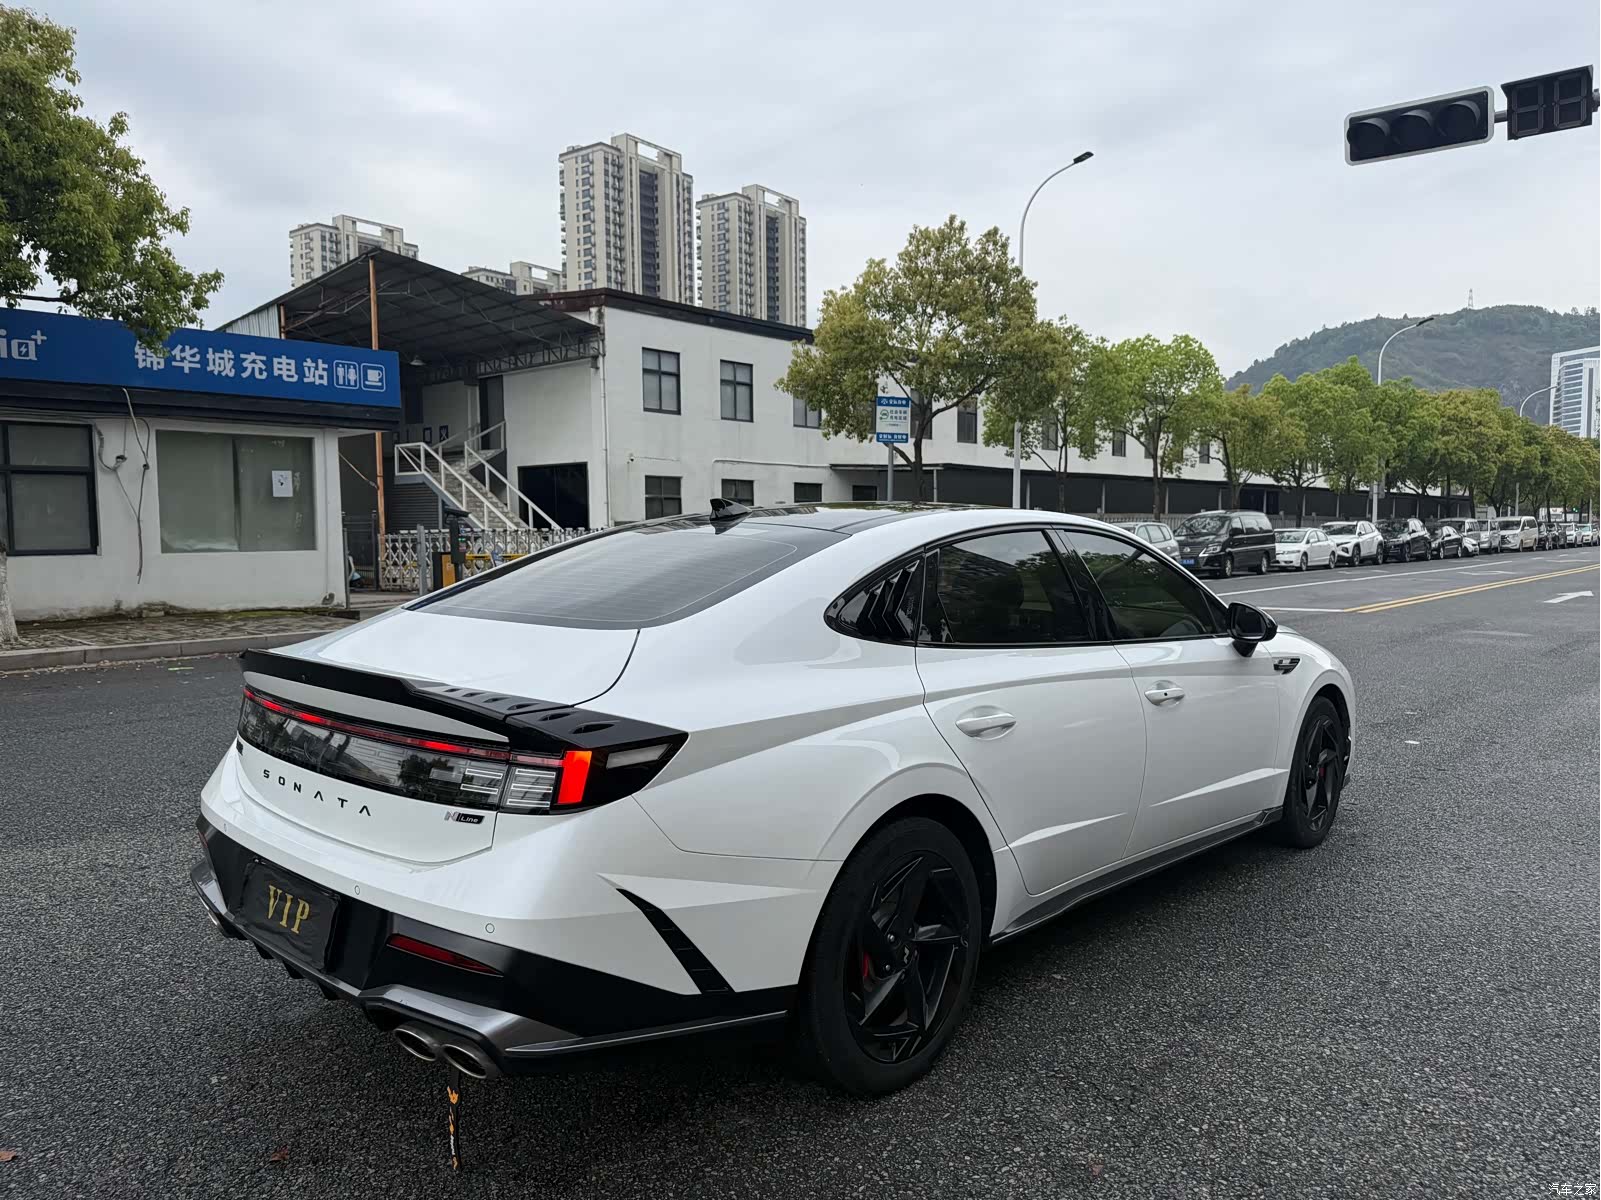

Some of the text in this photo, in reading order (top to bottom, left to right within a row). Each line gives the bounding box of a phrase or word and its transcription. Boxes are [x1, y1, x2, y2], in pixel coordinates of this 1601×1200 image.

[134, 340, 329, 386] 锦华城充电站
[263, 769, 371, 817] SONATA
[267, 885, 310, 934] VIP
